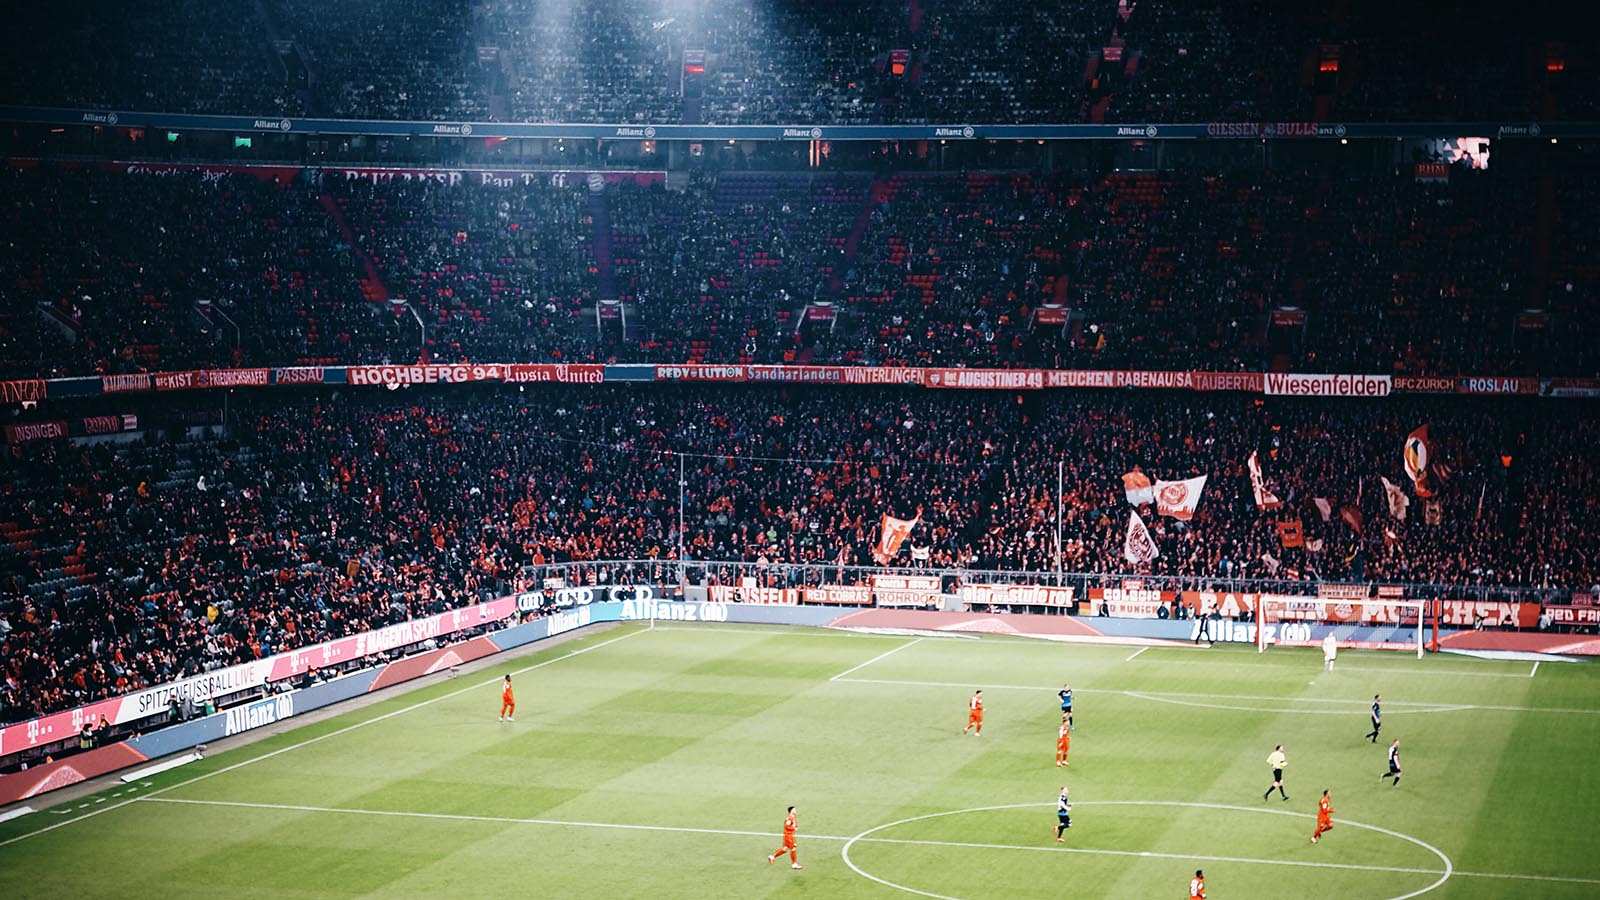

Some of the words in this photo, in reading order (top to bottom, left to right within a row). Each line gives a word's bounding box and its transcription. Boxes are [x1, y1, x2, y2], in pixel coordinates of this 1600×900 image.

[83, 112, 107, 122] Allianz
[254, 119, 280, 129] Allianz
[433, 124, 460, 134] Allianz
[616, 127, 644, 137] Allianz
[784, 128, 811, 138] Allianz
[935, 127, 962, 137] Allianz
[1117, 126, 1145, 137] Allianz
[1207, 122, 1259, 136] GIESSEN
[1276, 123, 1320, 136] BULLS
[1499, 125, 1527, 135] Allianz
[481, 172, 514, 188] Fan
[167, 372, 193, 389] KIST
[209, 370, 268, 387] FRIEDRICHSHAFEN
[275, 367, 324, 384] PASSAU
[351, 365, 467, 385] HÖCHBERG
[555, 363, 604, 384] United
[747, 366, 840, 381] Sandharlanden
[844, 367, 925, 384] WINTERLINGEN
[958, 372, 1026, 387] AUGUSTINER
[1027, 373, 1043, 388] 49
[1050, 372, 1113, 386] MEUCHEN
[1116, 372, 1193, 387] RABENAU/SA
[1195, 375, 1264, 390] TAUBERTAL
[1267, 373, 1388, 395] Wiesenfelden
[1394, 378, 1415, 390] BFC
[1469, 378, 1519, 393] ROSLAU
[711, 586, 799, 606] WENSFELD
[806, 589, 827, 601] RED
[829, 590, 870, 602] COBRAS
[621, 600, 697, 621] Allianz
[547, 611, 579, 637] Allianz
[367, 623, 414, 652] MAGENTA
[414, 617, 441, 642] SPORT
[138, 673, 233, 714] SPITZENFUSSBALL
[234, 665, 256, 688] LIVE
[225, 703, 276, 737] Allianz
